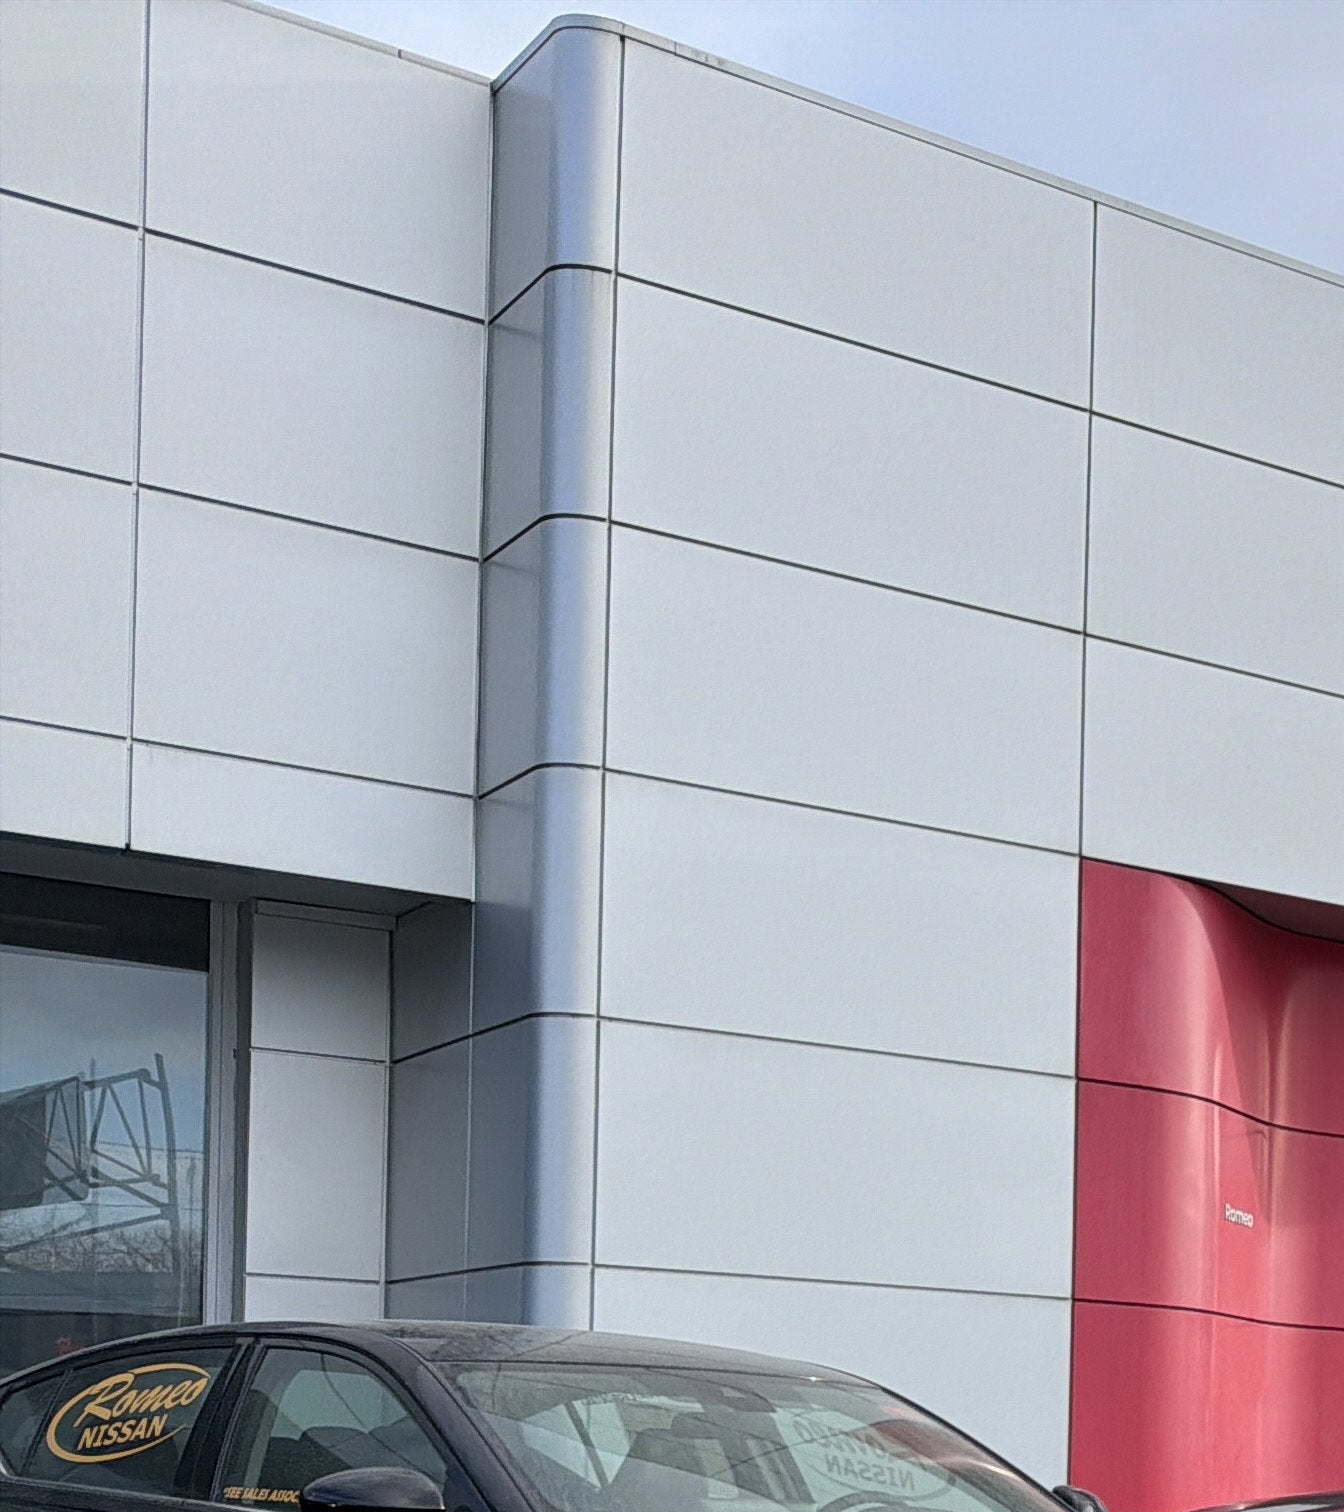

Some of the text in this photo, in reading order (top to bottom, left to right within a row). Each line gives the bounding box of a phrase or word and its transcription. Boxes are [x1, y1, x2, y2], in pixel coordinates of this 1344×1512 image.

[73, 1372, 208, 1428] Romeo
[77, 1414, 168, 1451] NISSAN
[241, 1487, 270, 1501] SALES
